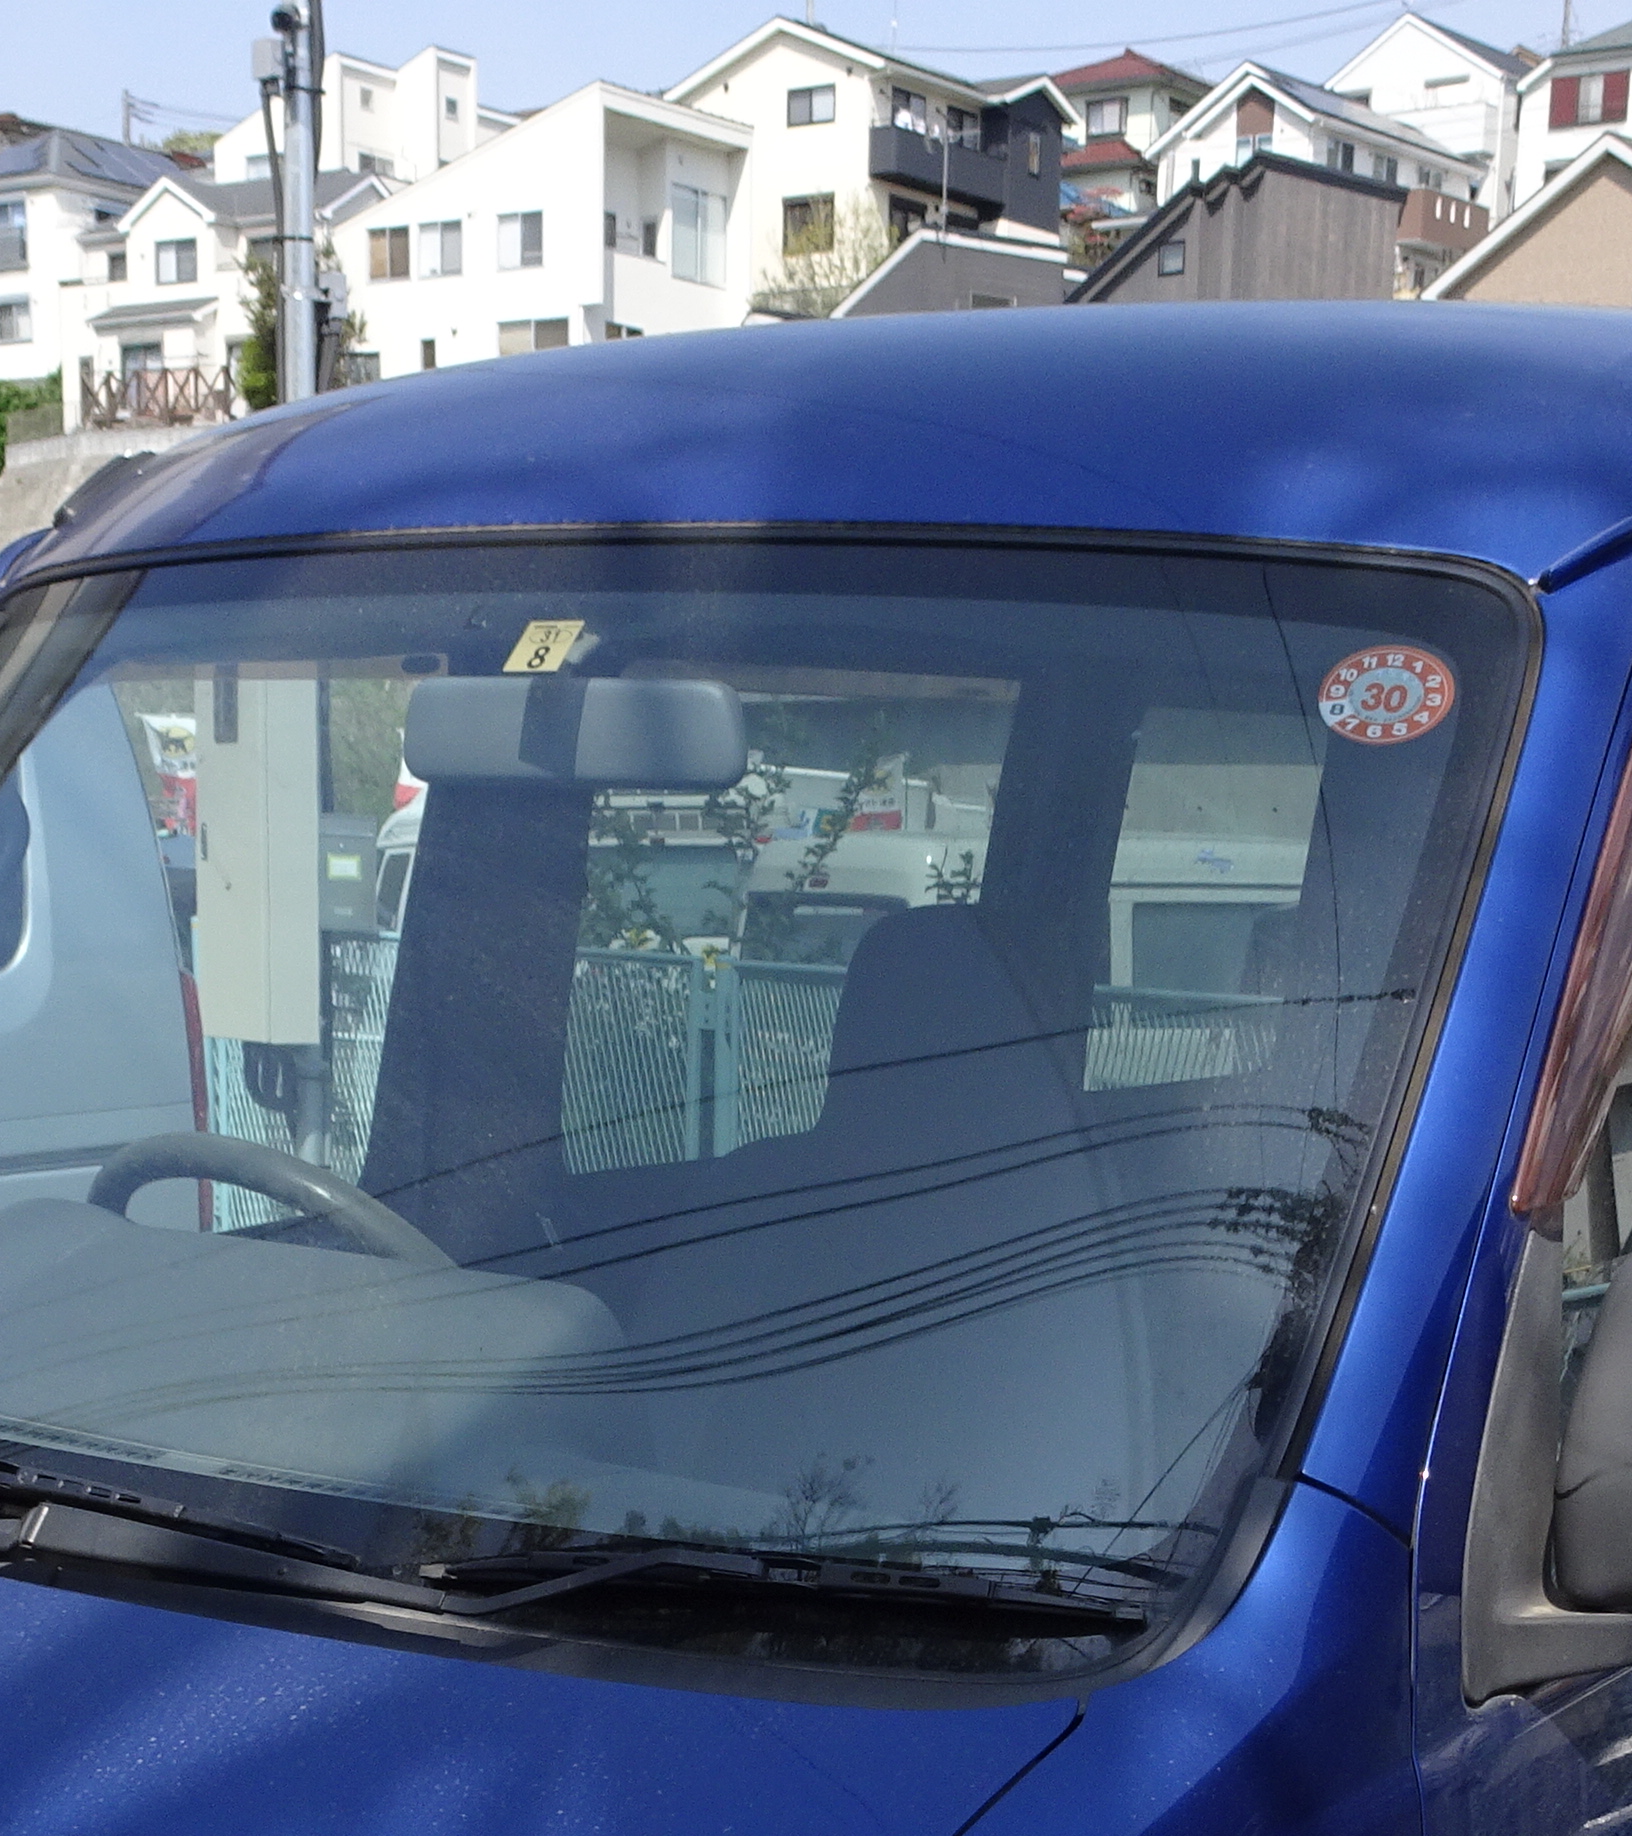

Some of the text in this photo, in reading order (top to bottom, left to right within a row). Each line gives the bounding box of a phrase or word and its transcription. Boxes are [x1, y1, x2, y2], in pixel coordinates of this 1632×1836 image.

[527, 646, 551, 669] 8
[1362, 656, 1377, 668] 11
[1386, 654, 1405, 667] 12
[1413, 661, 1424, 673] 1
[1339, 668, 1358, 681] 10
[1426, 675, 1442, 688] 2
[1330, 685, 1345, 698] 9
[1360, 682, 1408, 714] 30
[1426, 694, 1442, 706] 3
[1329, 704, 1345, 715] 8
[1413, 711, 1429, 724] 4
[1344, 718, 1360, 731] 7
[1392, 723, 1408, 735] 5
[1366, 725, 1383, 738] 6
